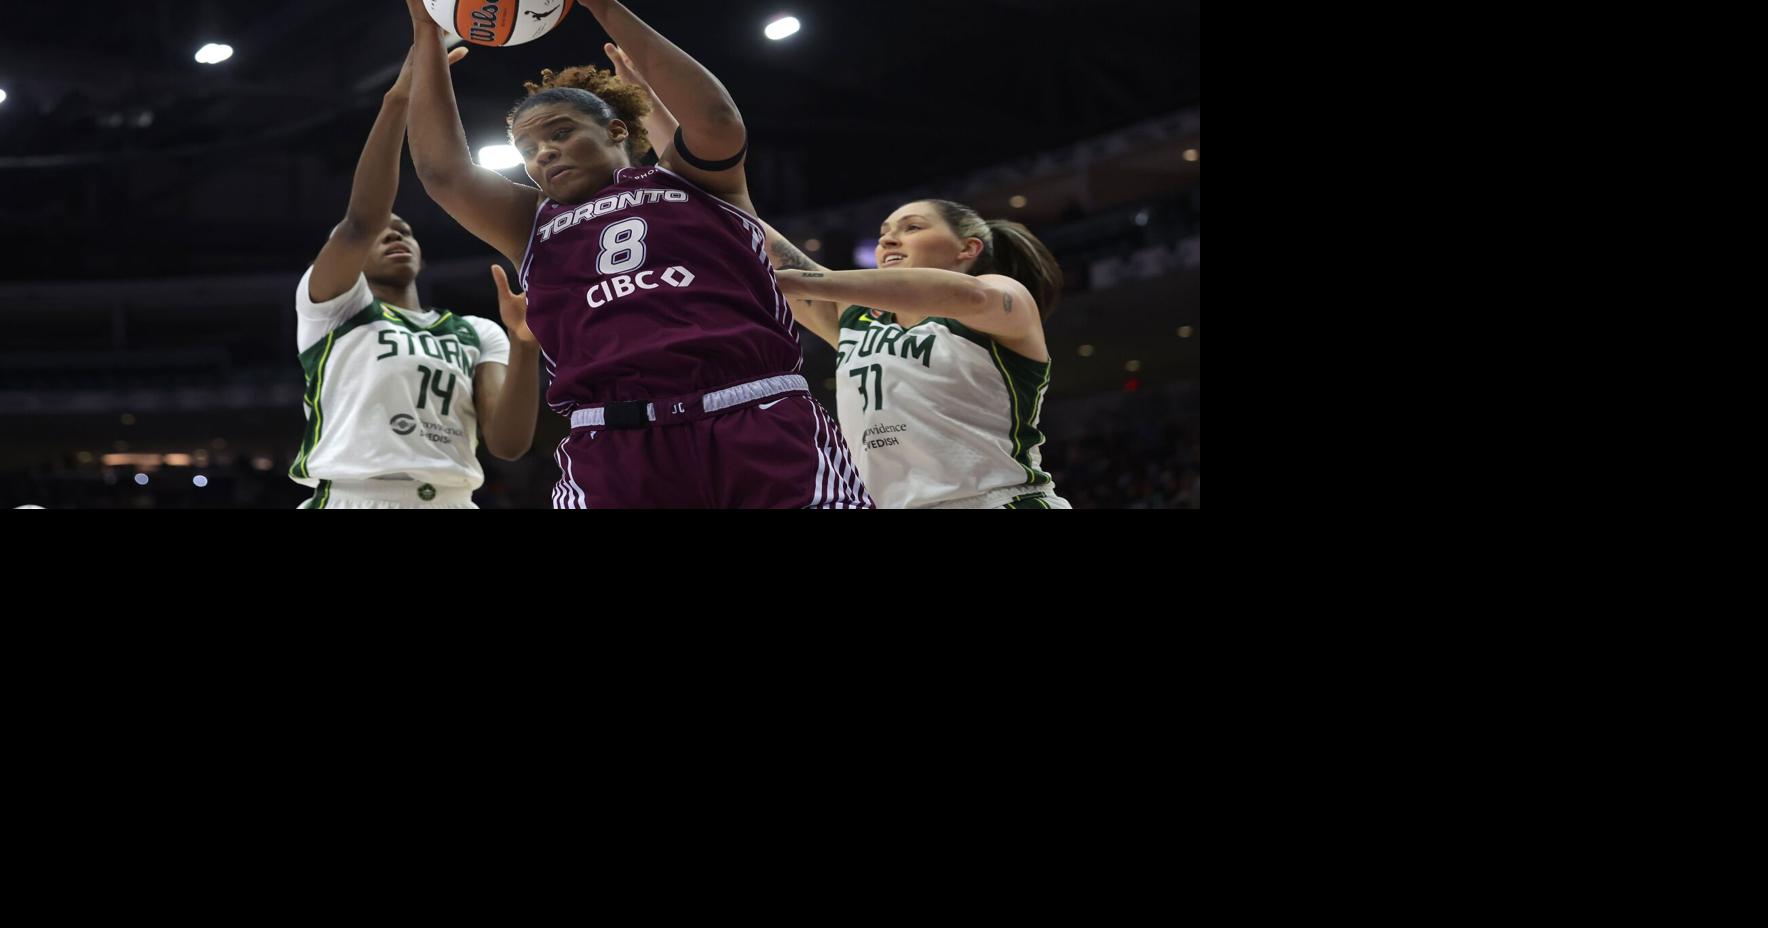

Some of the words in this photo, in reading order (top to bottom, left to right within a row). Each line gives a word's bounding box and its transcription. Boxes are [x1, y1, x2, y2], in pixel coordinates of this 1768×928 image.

[471, 0, 499, 41] Wils
[536, 188, 689, 243] TORONTO
[595, 216, 648, 275] 8
[586, 270, 660, 308] CIBC
[416, 365, 456, 416] 14
[849, 363, 883, 414] 31
[865, 437, 900, 451] EDISH
